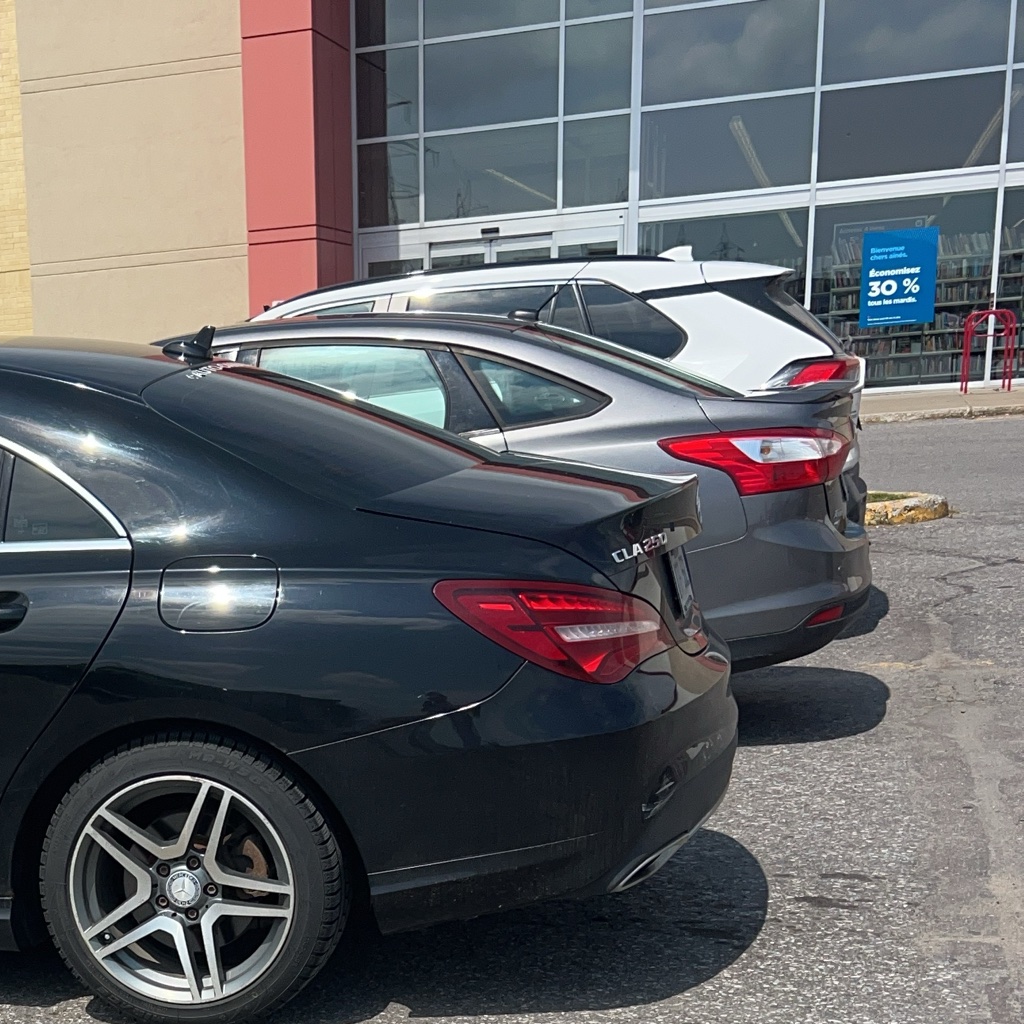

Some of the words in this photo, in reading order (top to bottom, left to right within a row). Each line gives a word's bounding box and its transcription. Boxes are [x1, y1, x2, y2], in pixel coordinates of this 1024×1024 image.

[870, 246, 905, 254] Bienvenue
[869, 267, 921, 278] Économisez
[867, 279, 898, 297] 30
[902, 277, 920, 294] %
[611, 545, 644, 563] CLA
[643, 533, 668, 551] 250
